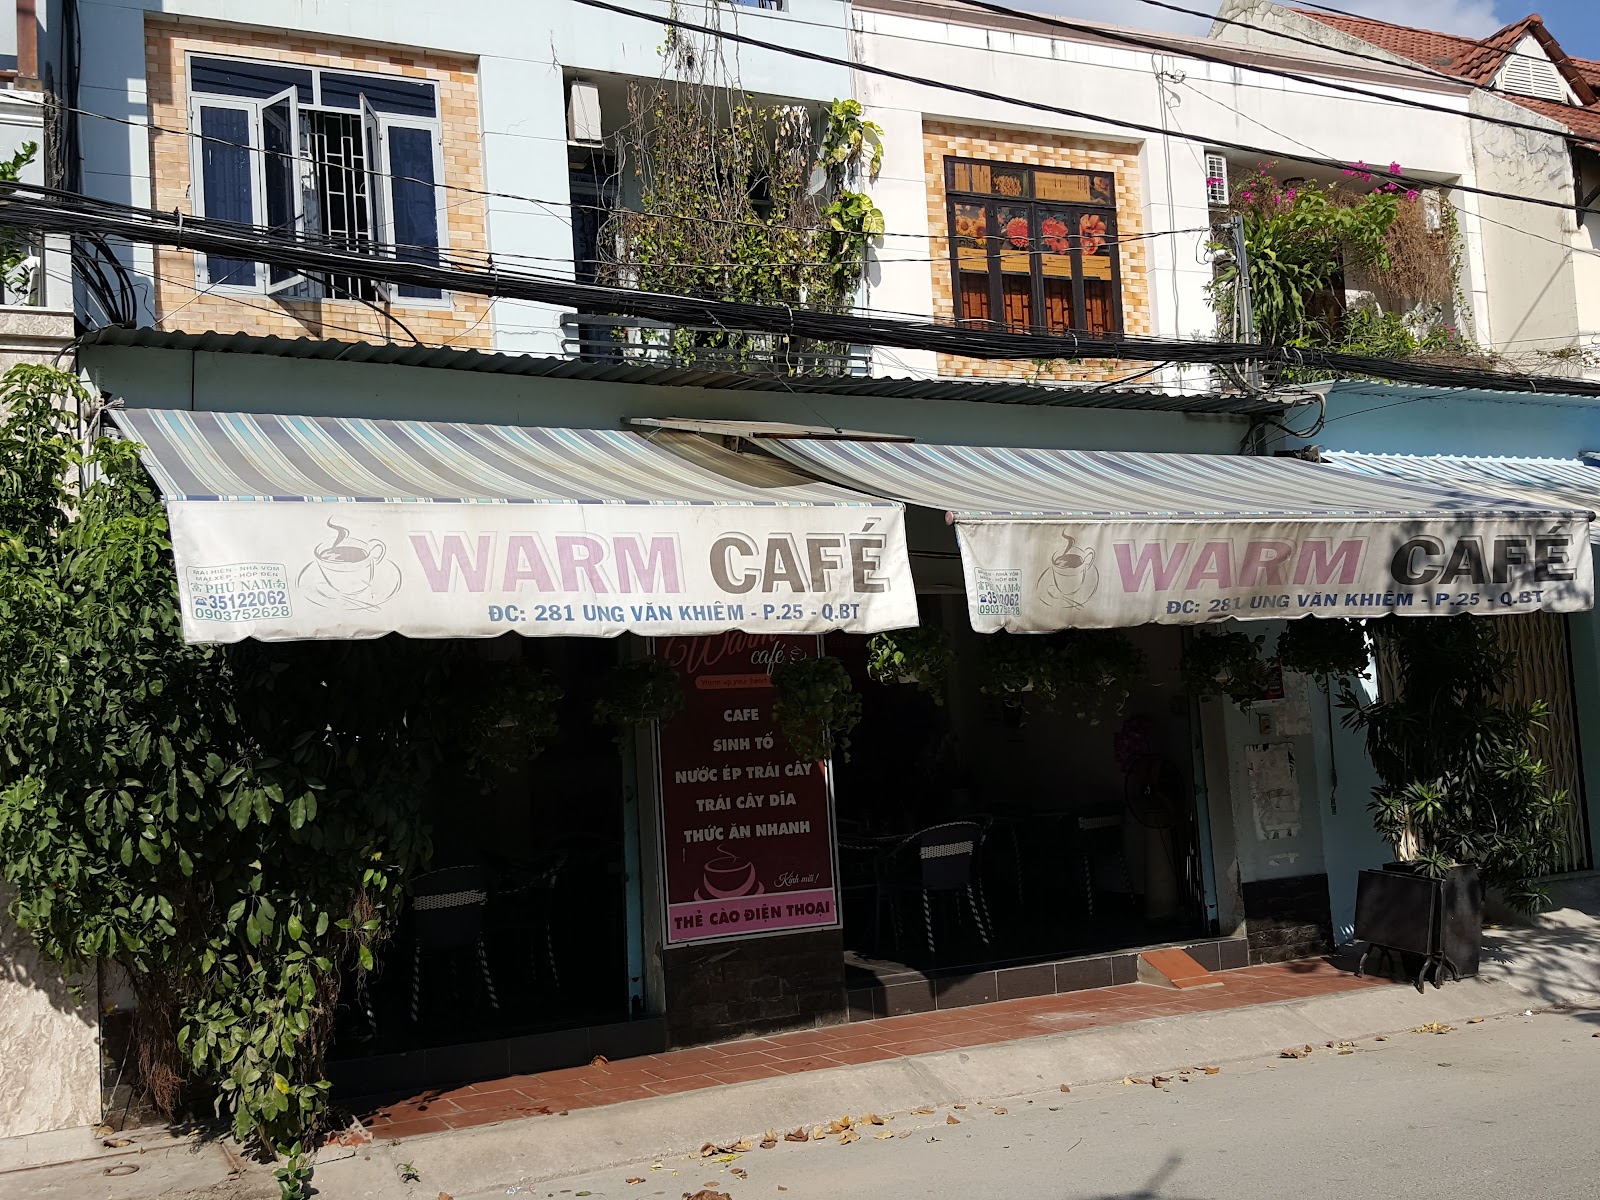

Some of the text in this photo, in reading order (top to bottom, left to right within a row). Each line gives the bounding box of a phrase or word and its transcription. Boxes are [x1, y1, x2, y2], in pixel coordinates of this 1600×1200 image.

[409, 518, 889, 594] WARM CAFÉ
[1113, 522, 1577, 593] WARM CAFÉ
[205, 578, 273, 594] PHÚ NAM
[996, 583, 1014, 593] NAM
[208, 591, 287, 609] 35122062
[488, 604, 527, 623] ĐC:
[534, 603, 575, 622] 281
[629, 601, 674, 622] VĂN
[680, 600, 745, 622] KHIÊM
[763, 603, 805, 621] P.25
[821, 602, 861, 621] Q.BT
[1166, 599, 1200, 614] ĐC:
[1208, 598, 1242, 613] 281
[1297, 590, 1343, 607] VĂN
[1344, 588, 1414, 606] KHIÊM
[1435, 592, 1480, 606] P.25
[1499, 590, 1545, 607] Q.BT
[195, 606, 290, 620] 0903752628
[751, 640, 786, 676] café
[723, 708, 760, 722] CAFE
[713, 731, 774, 752] SINH TỐ
[675, 759, 813, 784] NƯỚC ÉP TRÁI CÂY
[696, 790, 797, 812] TRÁI CÂY DĨA
[684, 820, 811, 843] THỨC ĂN NHANH
[674, 901, 831, 930] THẺ CÀO ĐIỆN THOẠI
